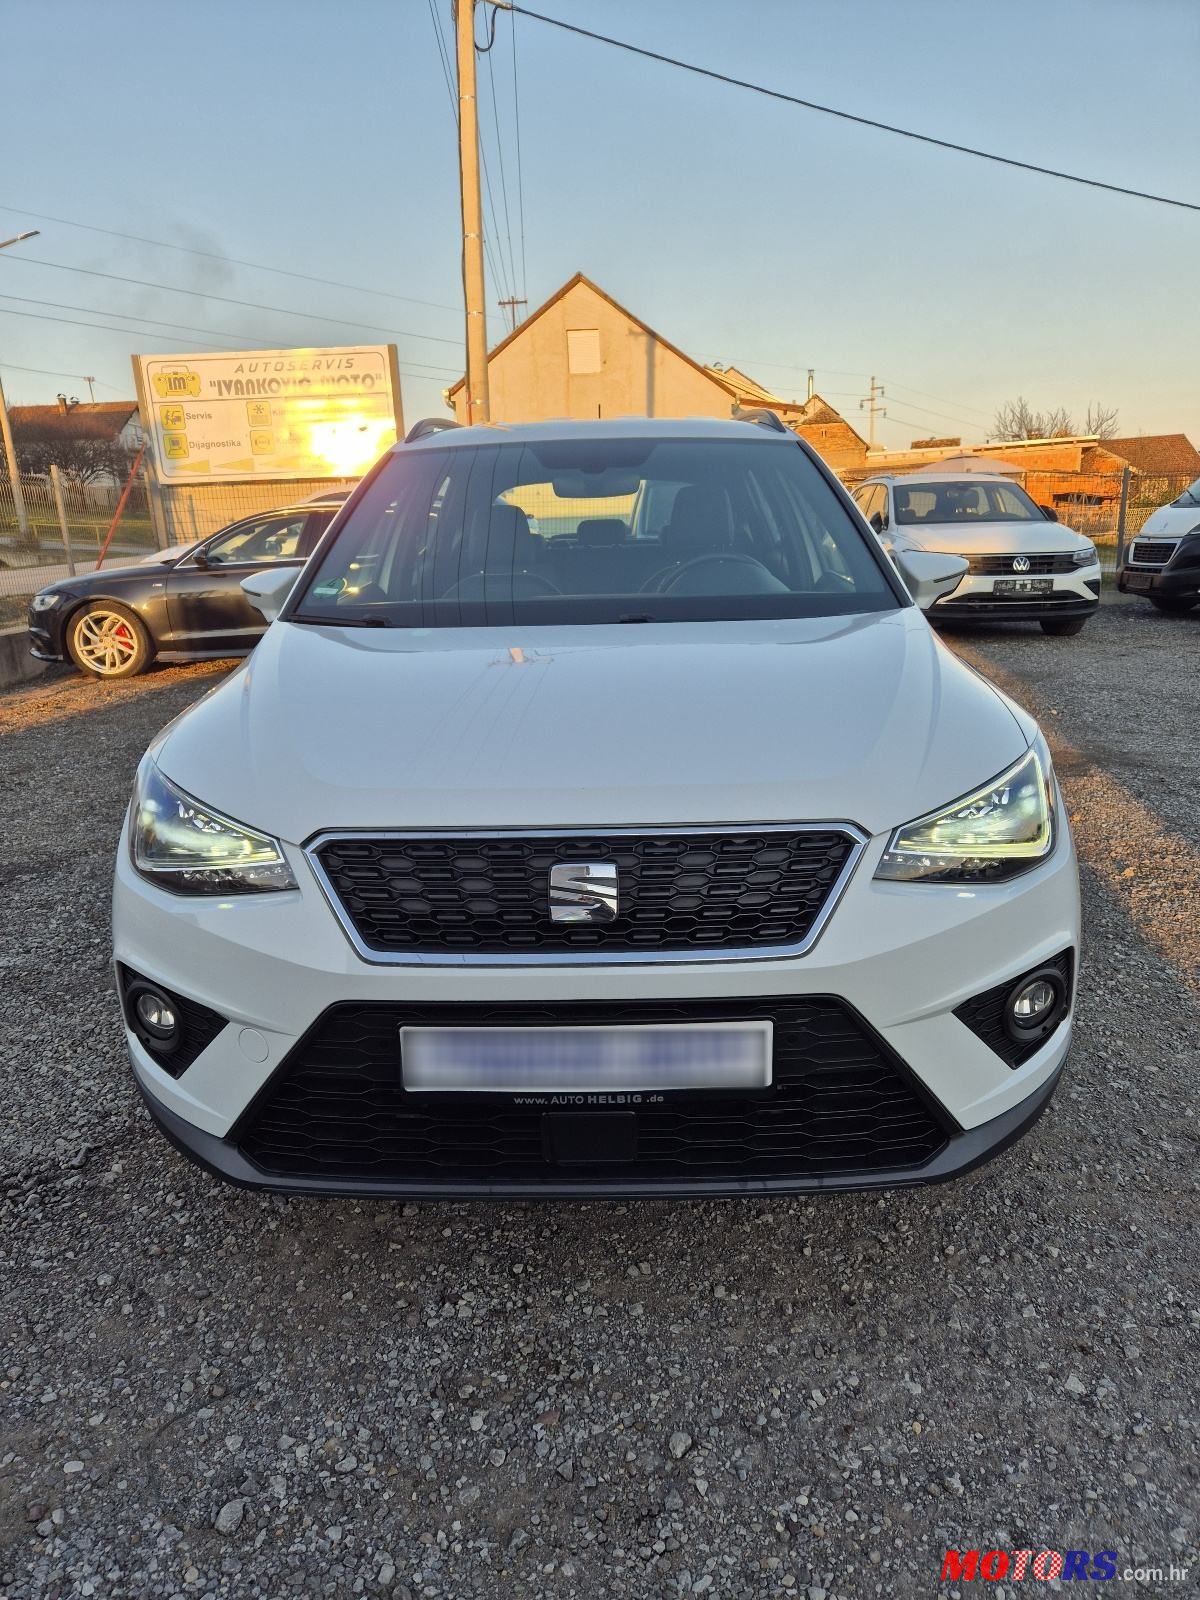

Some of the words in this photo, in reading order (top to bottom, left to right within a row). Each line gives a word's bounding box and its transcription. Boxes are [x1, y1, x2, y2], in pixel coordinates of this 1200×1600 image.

[234, 358, 355, 374] AUTOSERVIS
[185, 411, 213, 421] Servis
[188, 439, 242, 450] Dijagnostika
[550, 1095, 585, 1104] AUTO
[587, 1094, 642, 1104] HELBIG
